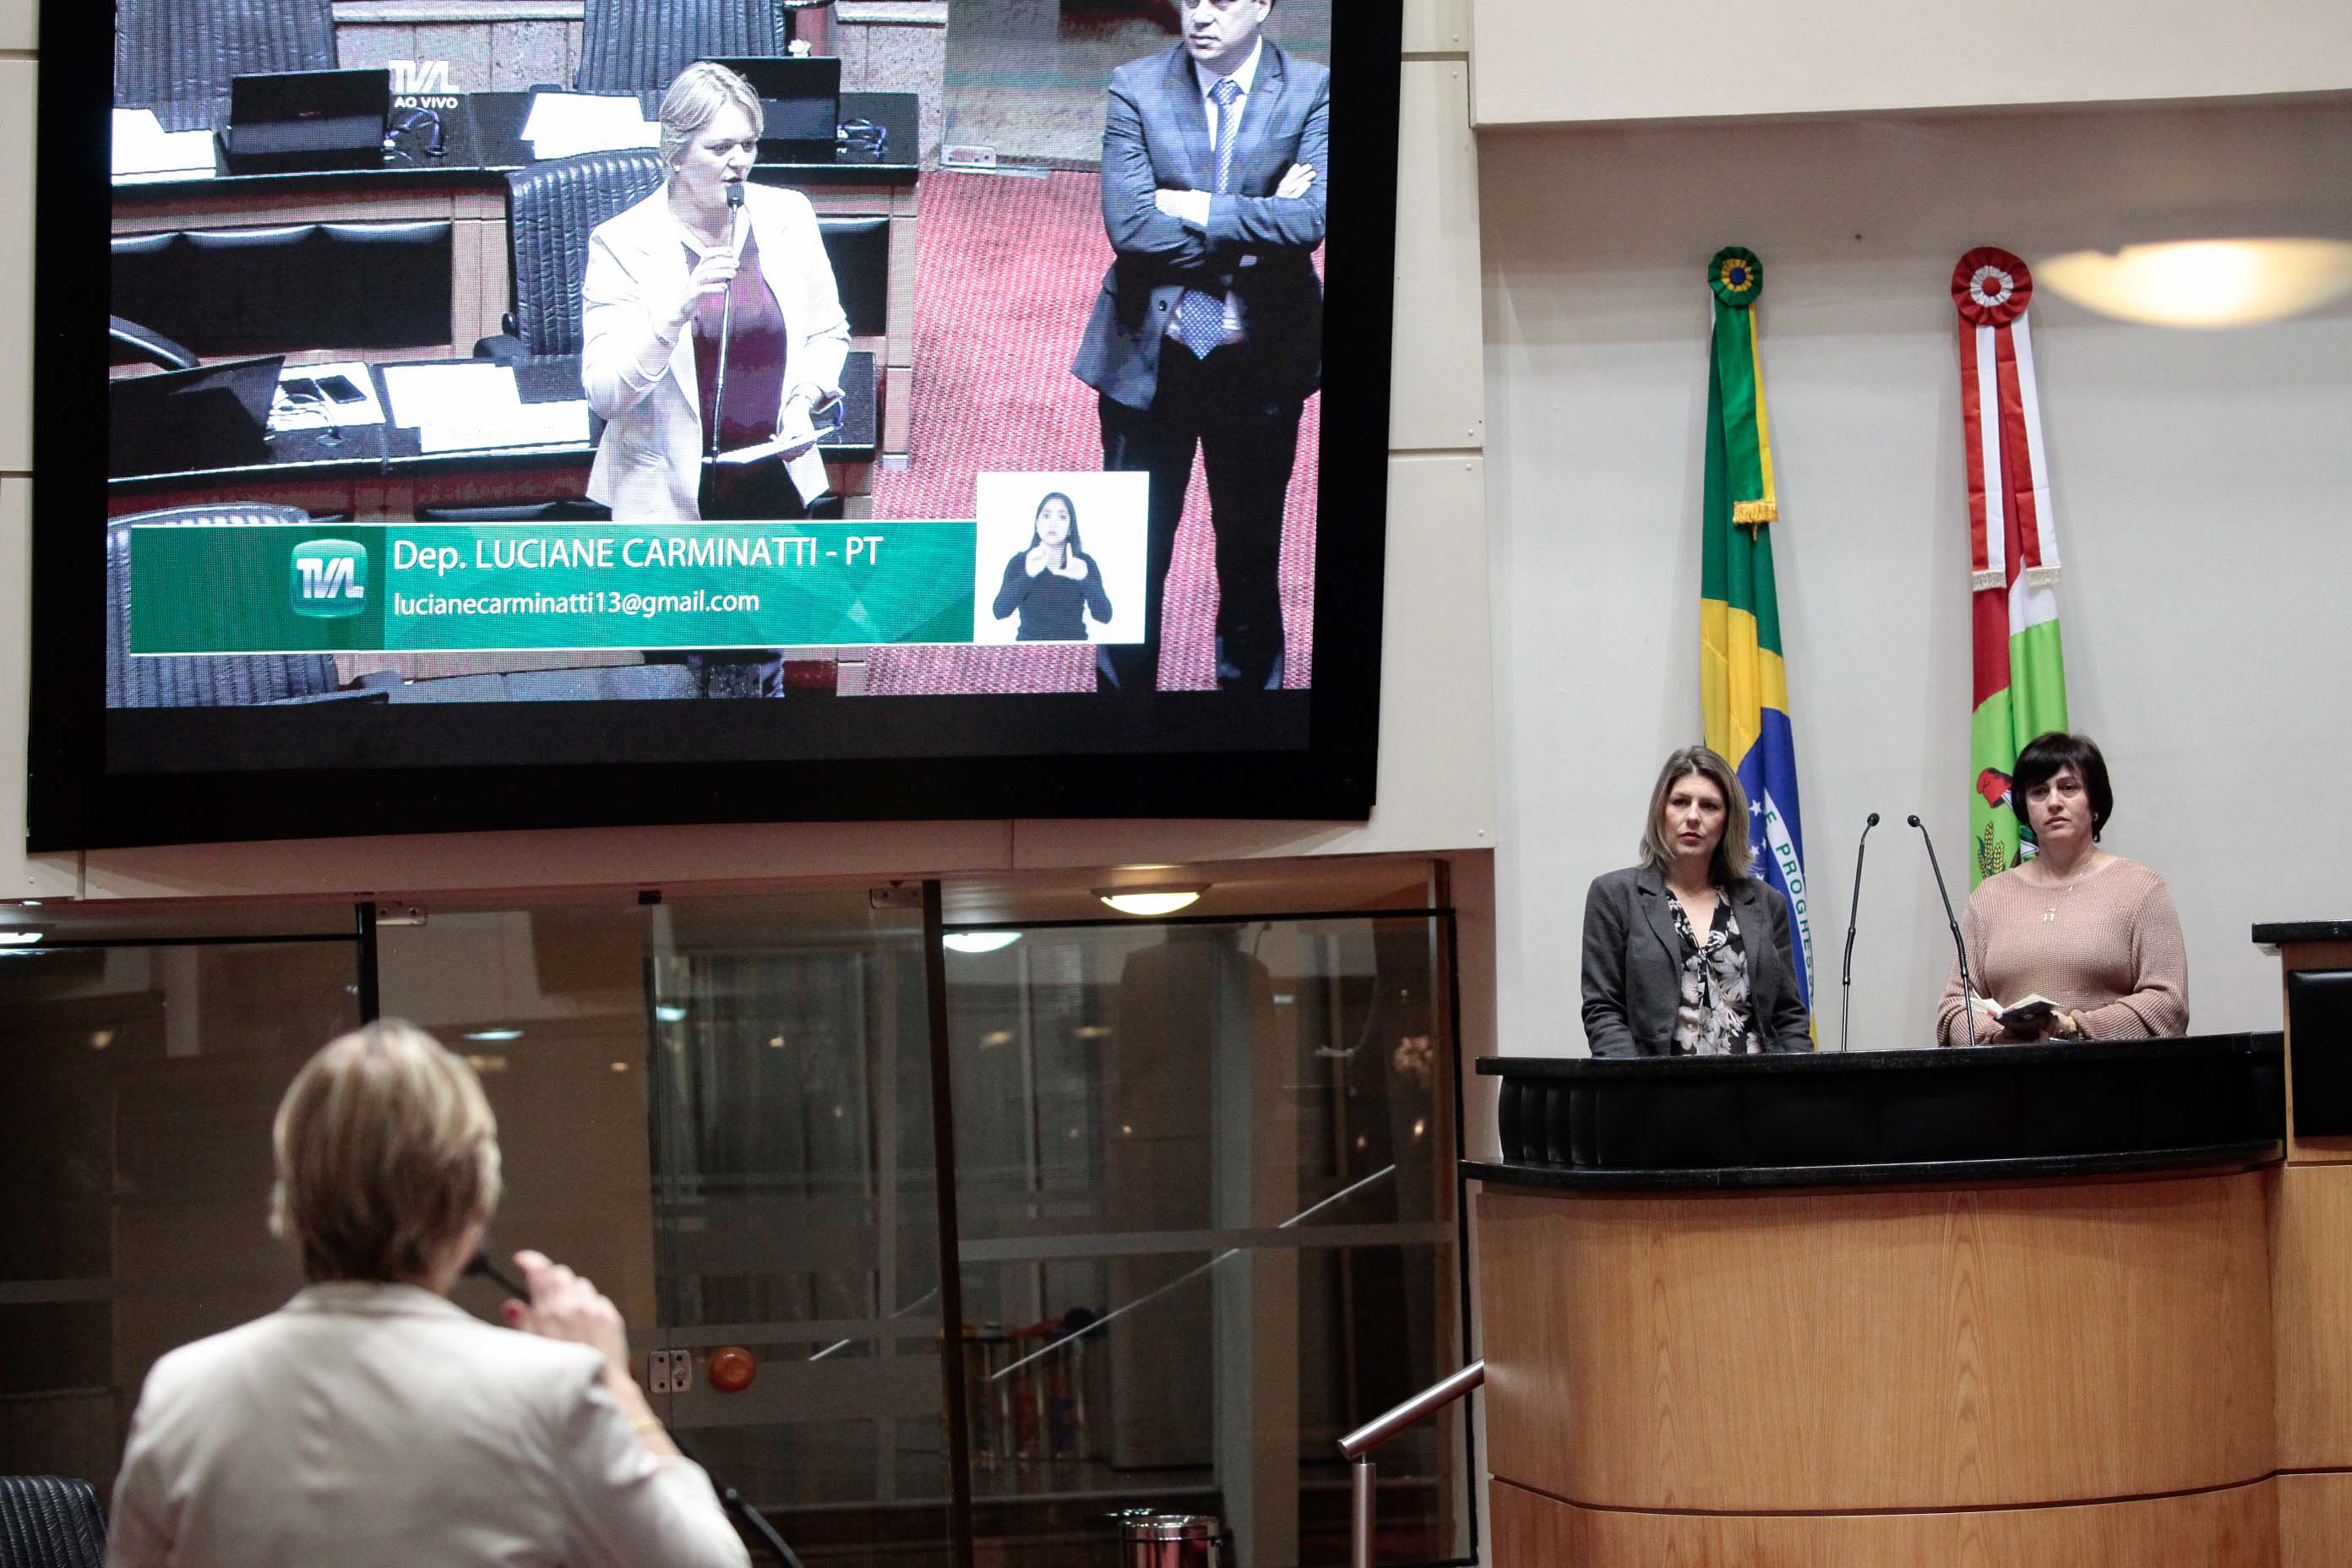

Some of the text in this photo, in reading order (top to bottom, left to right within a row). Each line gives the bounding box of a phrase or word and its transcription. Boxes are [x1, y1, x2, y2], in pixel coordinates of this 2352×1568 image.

[394, 96, 458, 109] AO VIVO
[394, 540, 467, 576] Dep.
[476, 538, 614, 569] LUCIANE
[622, 536, 816, 568] CARMINATTI
[846, 536, 884, 565] PT
[394, 589, 760, 618] lucianecarminatti13@gmail.com
